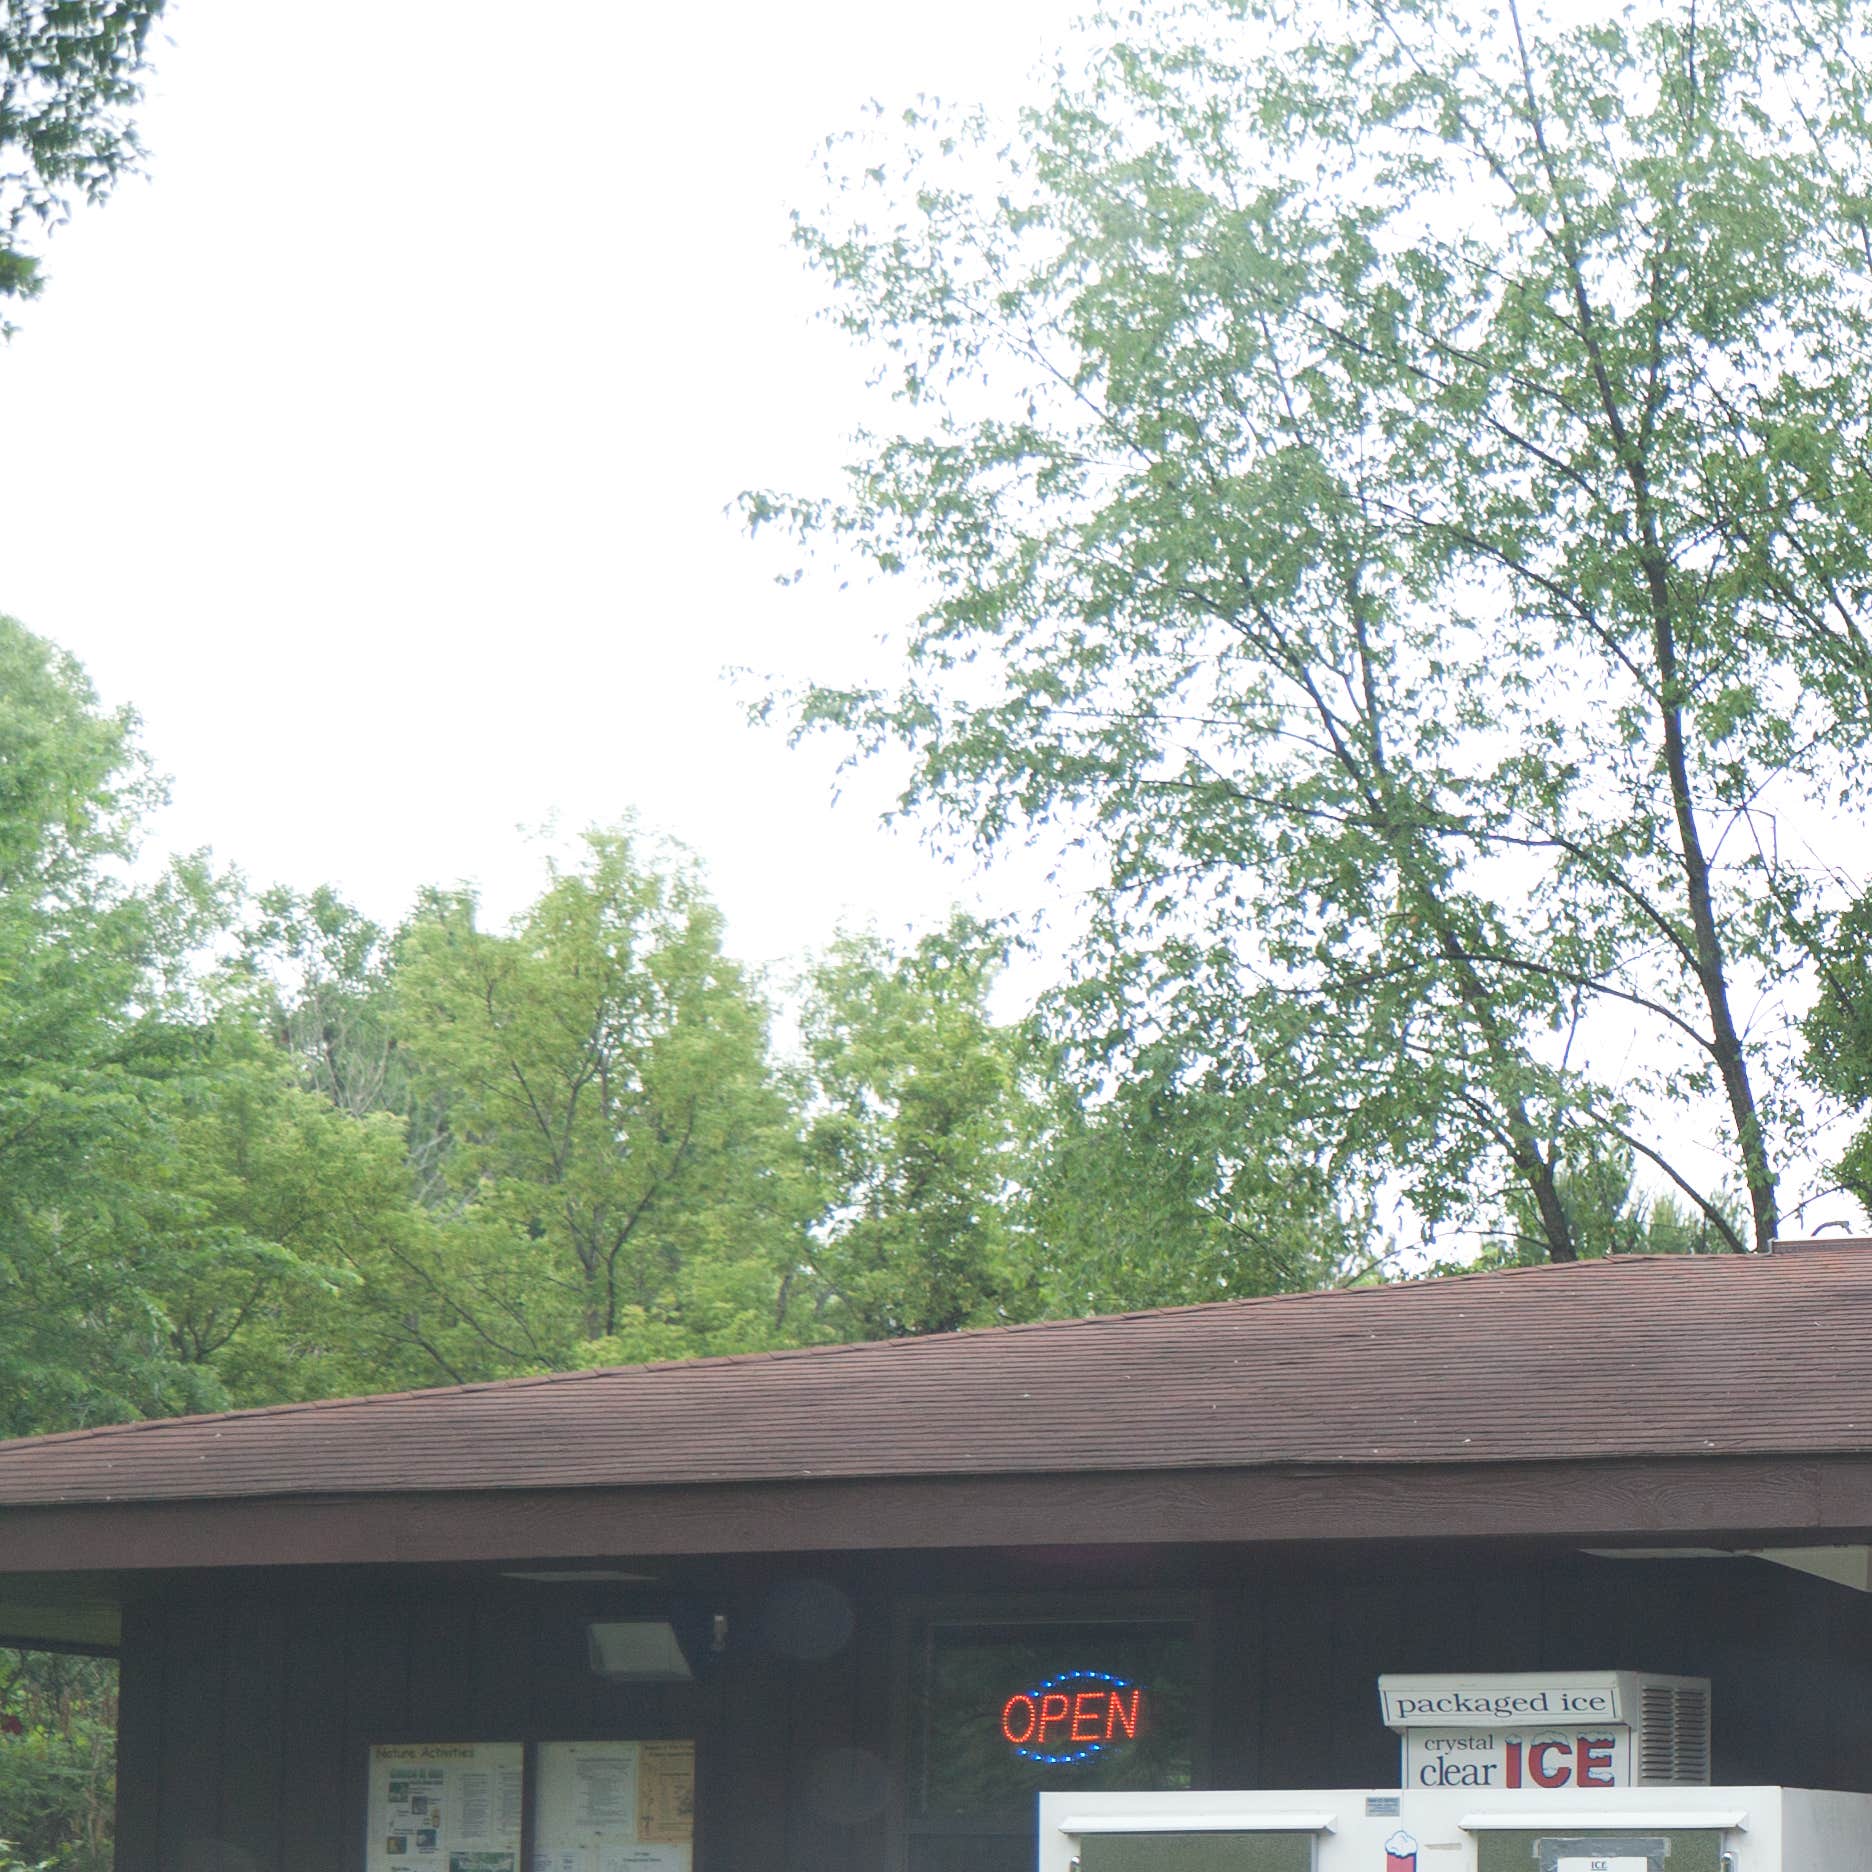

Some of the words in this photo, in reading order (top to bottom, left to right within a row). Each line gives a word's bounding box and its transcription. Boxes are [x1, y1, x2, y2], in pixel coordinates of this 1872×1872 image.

[1002, 1689, 1140, 1744] OPEN
[1398, 1692, 1550, 1719] packaged
[1561, 1692, 1607, 1713] ice
[1424, 1733, 1494, 1756] crystal
[1504, 1729, 1616, 1789] ICE
[1420, 1755, 1498, 1787] clear
[1591, 1861, 1608, 1870] ICE
